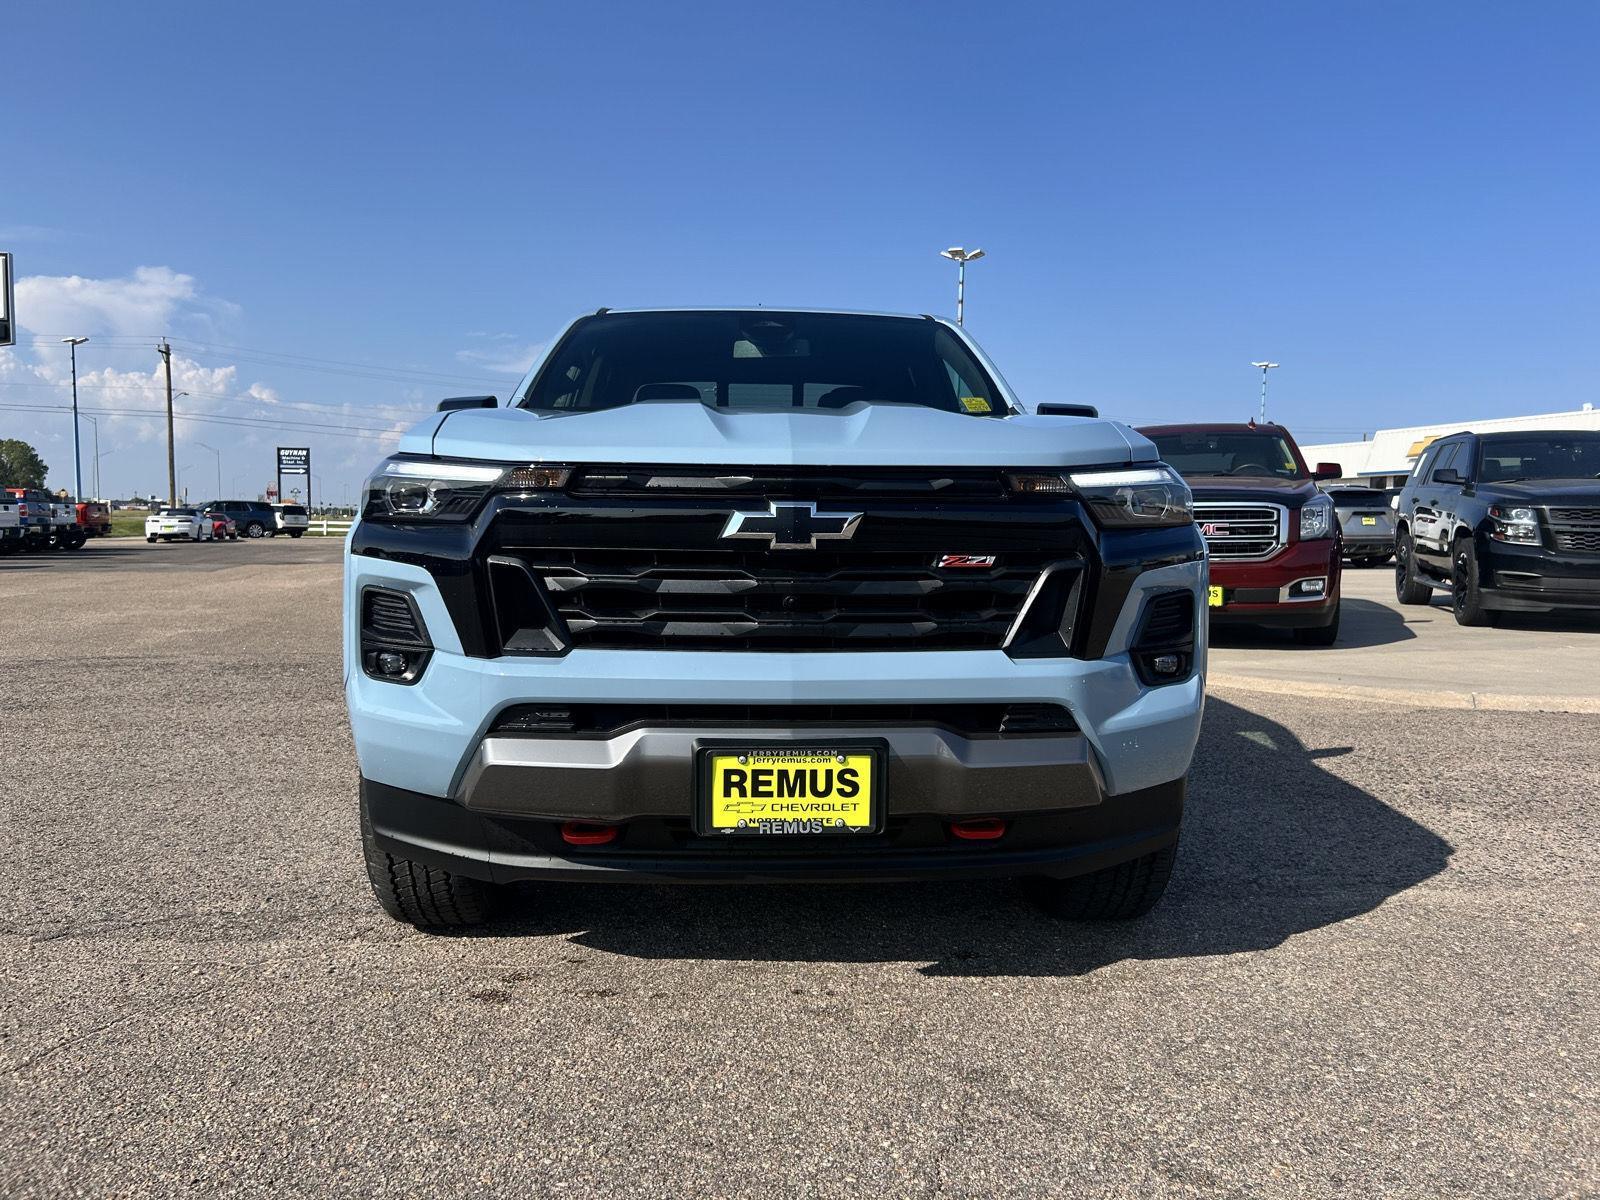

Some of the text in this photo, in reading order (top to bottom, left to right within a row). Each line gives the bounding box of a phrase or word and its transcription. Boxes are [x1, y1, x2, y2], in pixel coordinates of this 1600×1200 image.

[1200, 523, 1230, 535] MC
[938, 555, 996, 567] Z71
[753, 756, 832, 765] jerryremus.com
[723, 769, 860, 798] REMUS
[771, 803, 860, 811] CHEVROLET
[759, 821, 823, 834] REMUS
